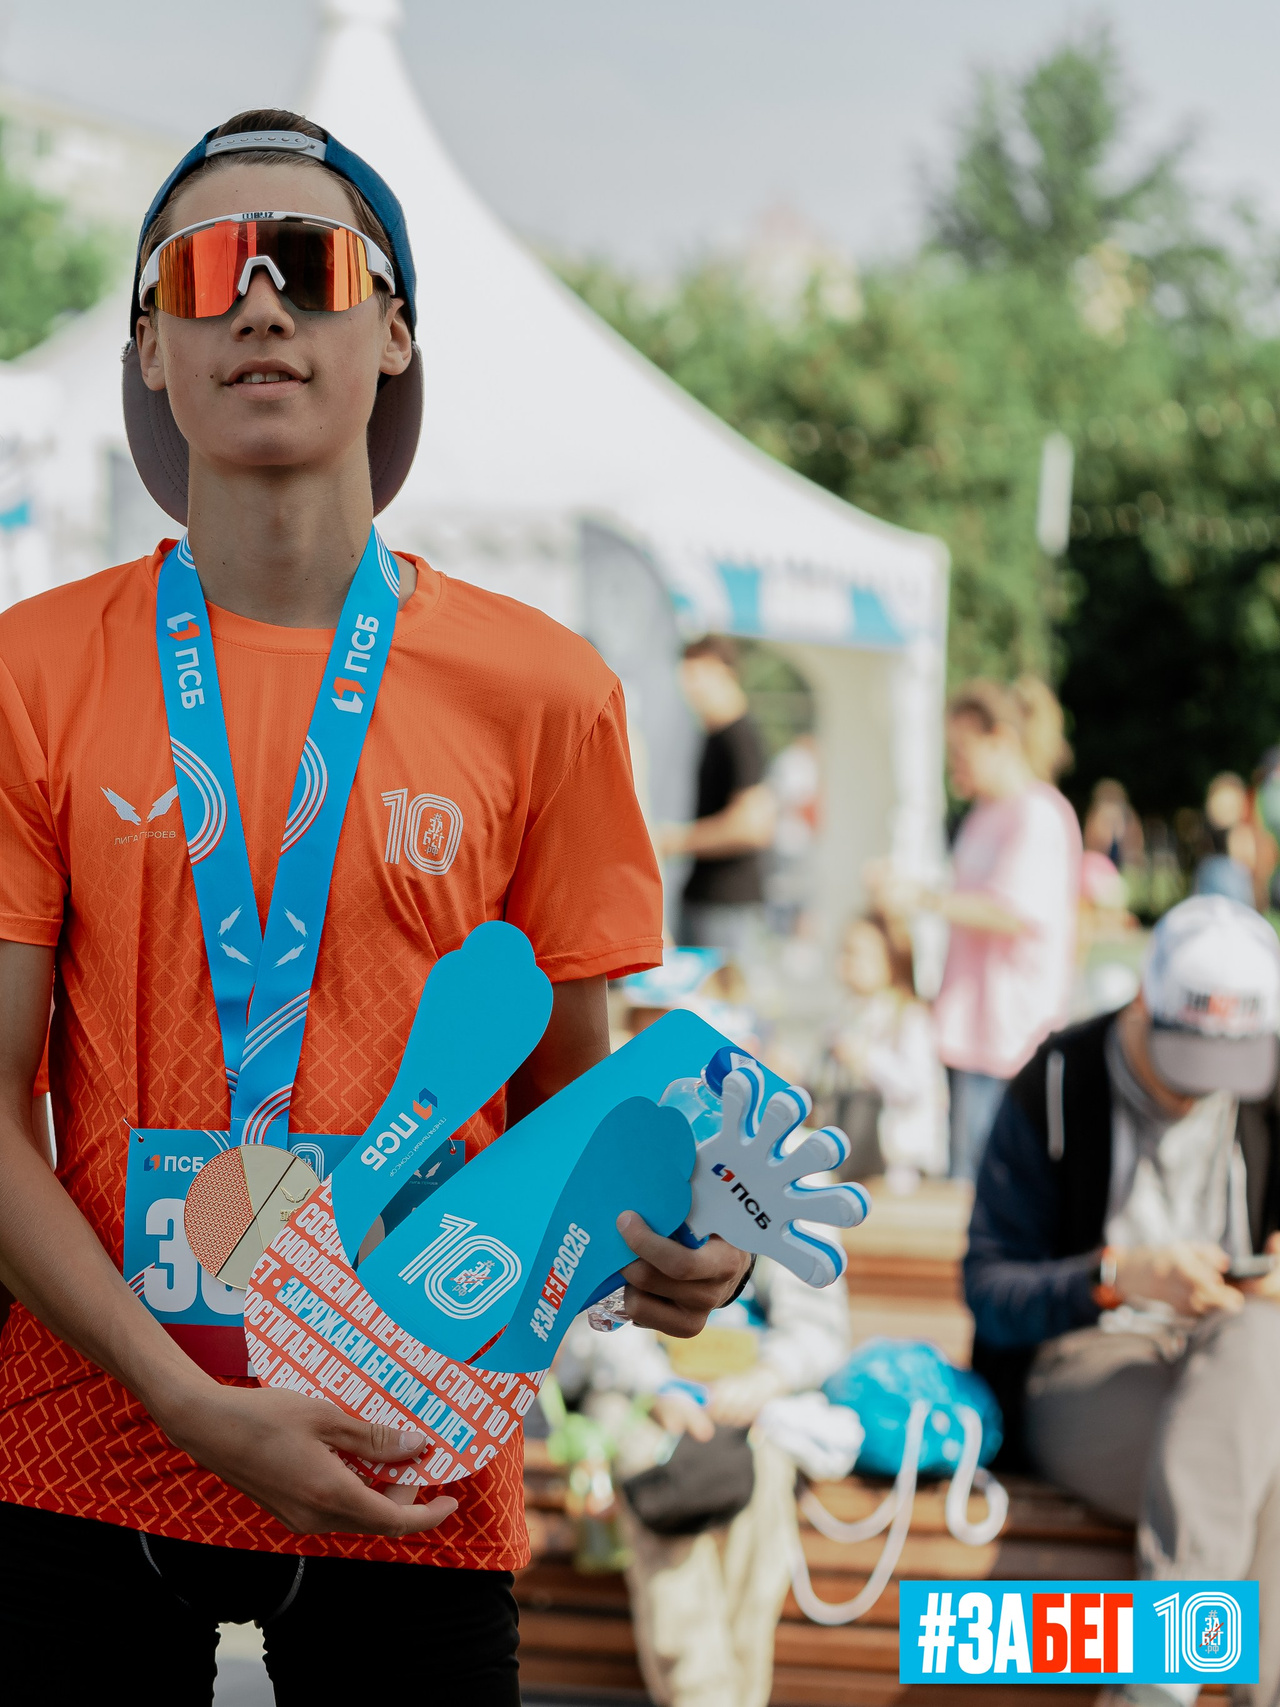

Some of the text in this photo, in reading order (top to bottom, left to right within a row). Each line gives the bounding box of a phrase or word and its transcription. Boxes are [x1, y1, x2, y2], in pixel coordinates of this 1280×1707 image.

[344, 613, 379, 673] ПСБ
[175, 647, 205, 709] ПСБ
[114, 834, 139, 846] ЛИГА
[381, 788, 463, 876] 10
[164, 1155, 204, 1172] ПСБ
[361, 1112, 419, 1171] ПСБ
[389, 1150, 415, 1177] СПОНСОР
[730, 1182, 771, 1230] ПСБ
[398, 1213, 522, 1319] 10
[529, 1222, 591, 1342] #ЗАБЕГ2026
[276, 1276, 371, 1364] ЗАРЯЖАЕМ
[362, 1348, 428, 1411] БЕГОМ
[420, 1394, 447, 1427] 10
[437, 1411, 478, 1454] ЛЕТ
[346, 1289, 375, 1326] НА
[436, 1365, 493, 1421] СТАРТ
[483, 1405, 510, 1438] 10
[316, 1356, 372, 1410] ЦЕЛИ
[424, 1447, 454, 1480] 10
